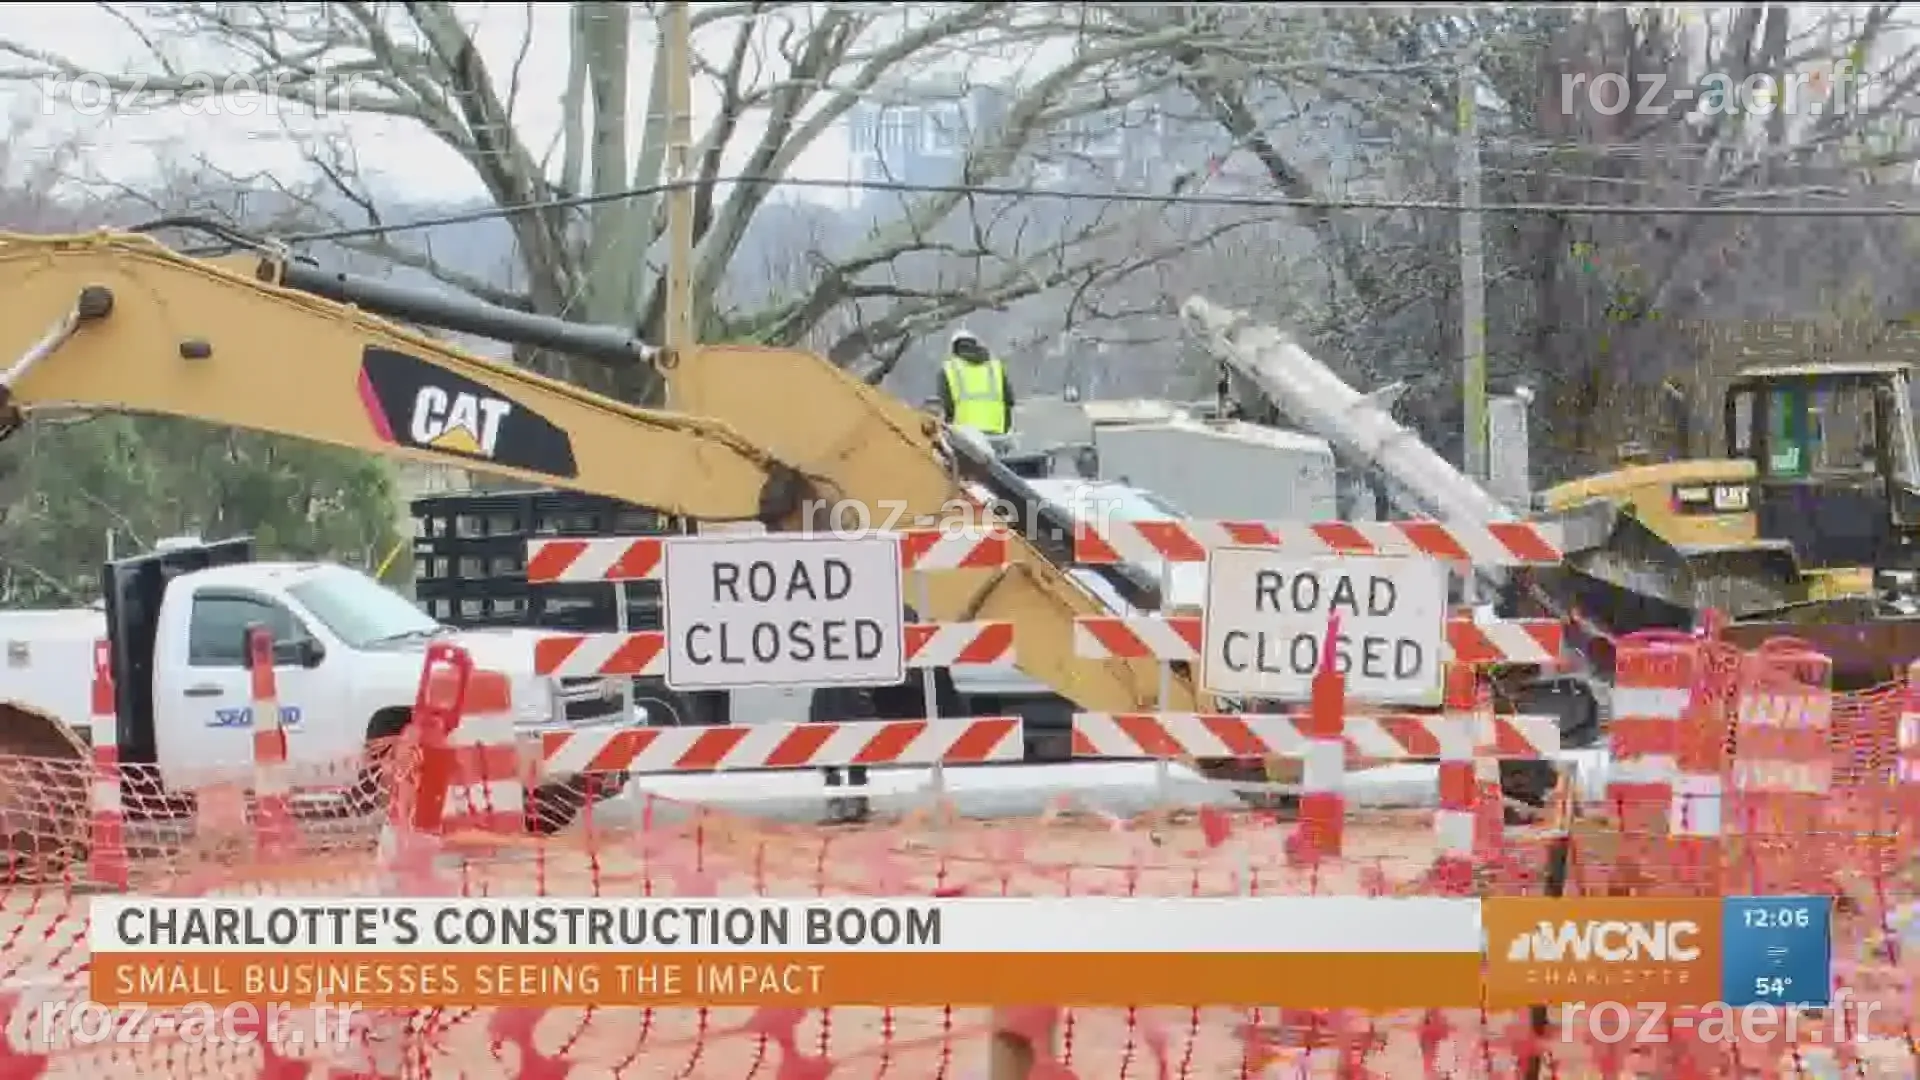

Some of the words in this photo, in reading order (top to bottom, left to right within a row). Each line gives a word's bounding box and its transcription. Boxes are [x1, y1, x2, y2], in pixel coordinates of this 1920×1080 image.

[411, 384, 511, 456] CAT
[711, 560, 853, 602] ROAD
[1255, 570, 1397, 617] ROAD
[684, 620, 884, 665] CLOSED
[1223, 630, 1423, 679] CLOSED
